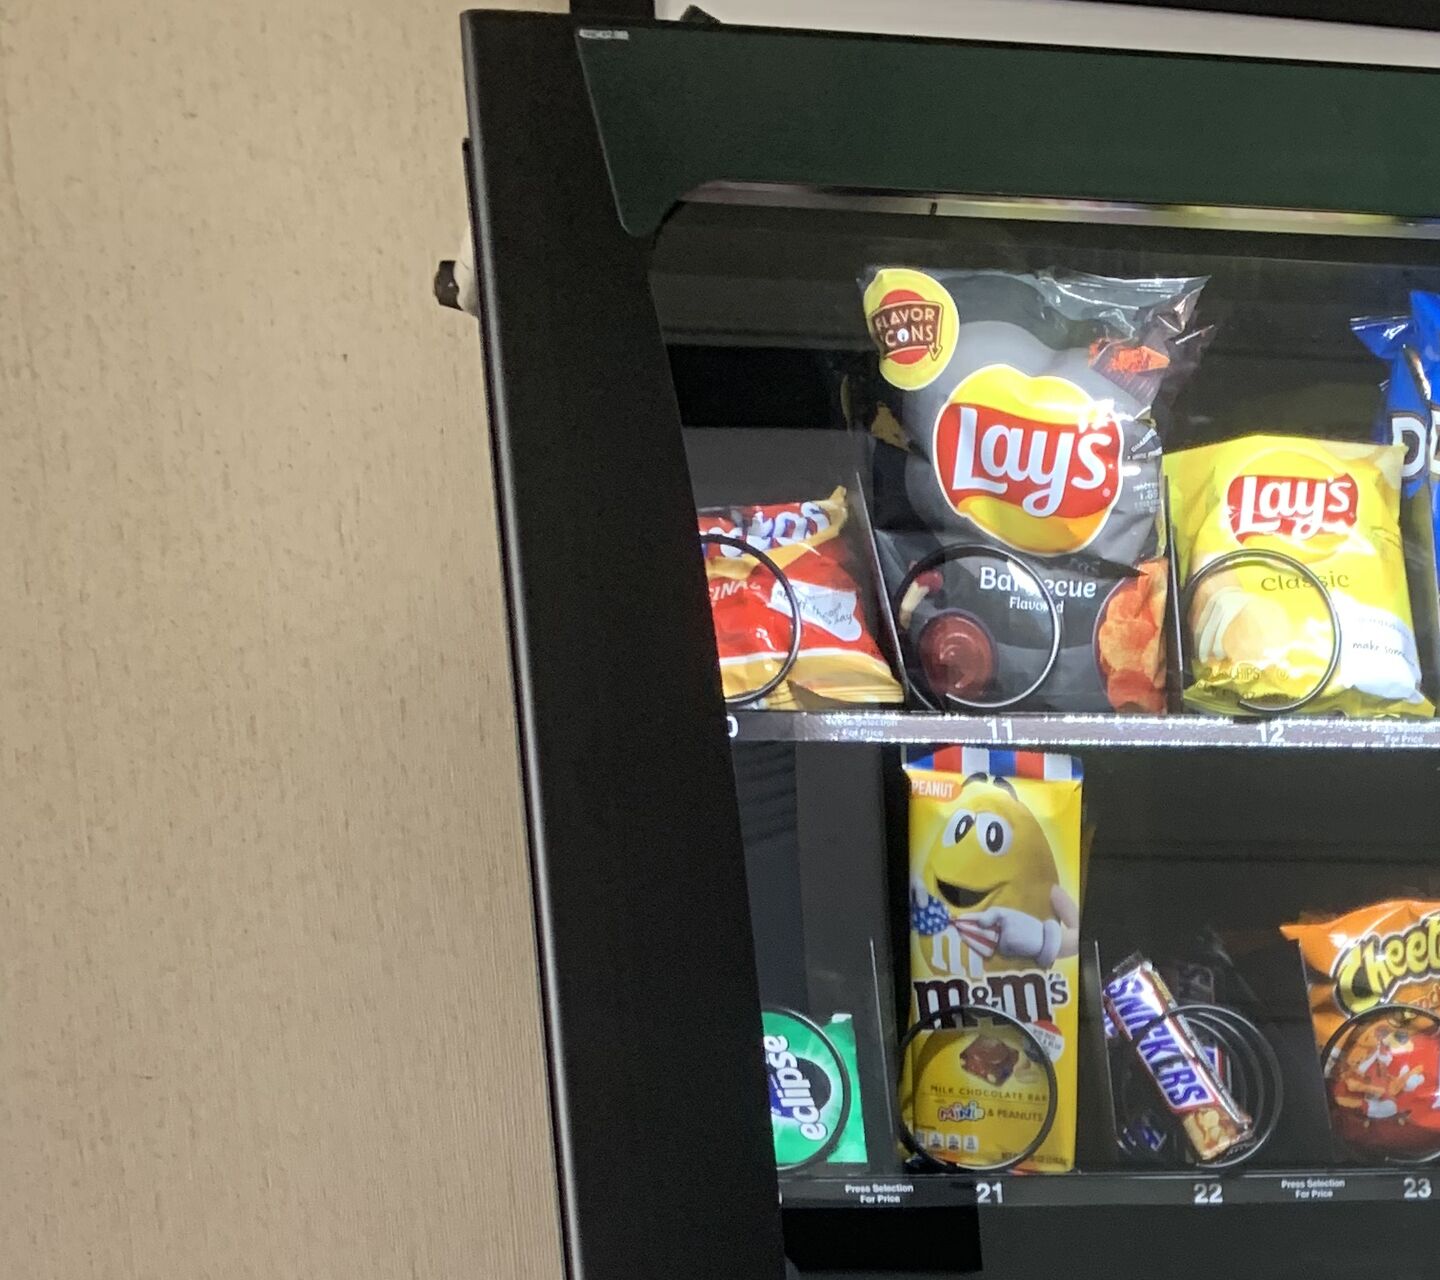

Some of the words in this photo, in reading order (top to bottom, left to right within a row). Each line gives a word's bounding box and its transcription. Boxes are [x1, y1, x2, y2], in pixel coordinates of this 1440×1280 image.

[875, 308, 935, 329] FLAVOR
[1239, 475, 1352, 540] Lay's
[987, 720, 1013, 740] 11
[1256, 724, 1285, 743] 12
[911, 781, 954, 799] PEANUT
[1106, 972, 1208, 1109] SNICKERS
[930, 1085, 954, 1095] MILK
[959, 1087, 1023, 1100] CHOCOLATE
[1194, 1183, 1223, 1203] 22
[1281, 1178, 1305, 1189] Press
[1307, 1177, 1345, 1189] Selection
[1404, 1178, 1431, 1198] 23
[976, 1183, 1004, 1205] 21
